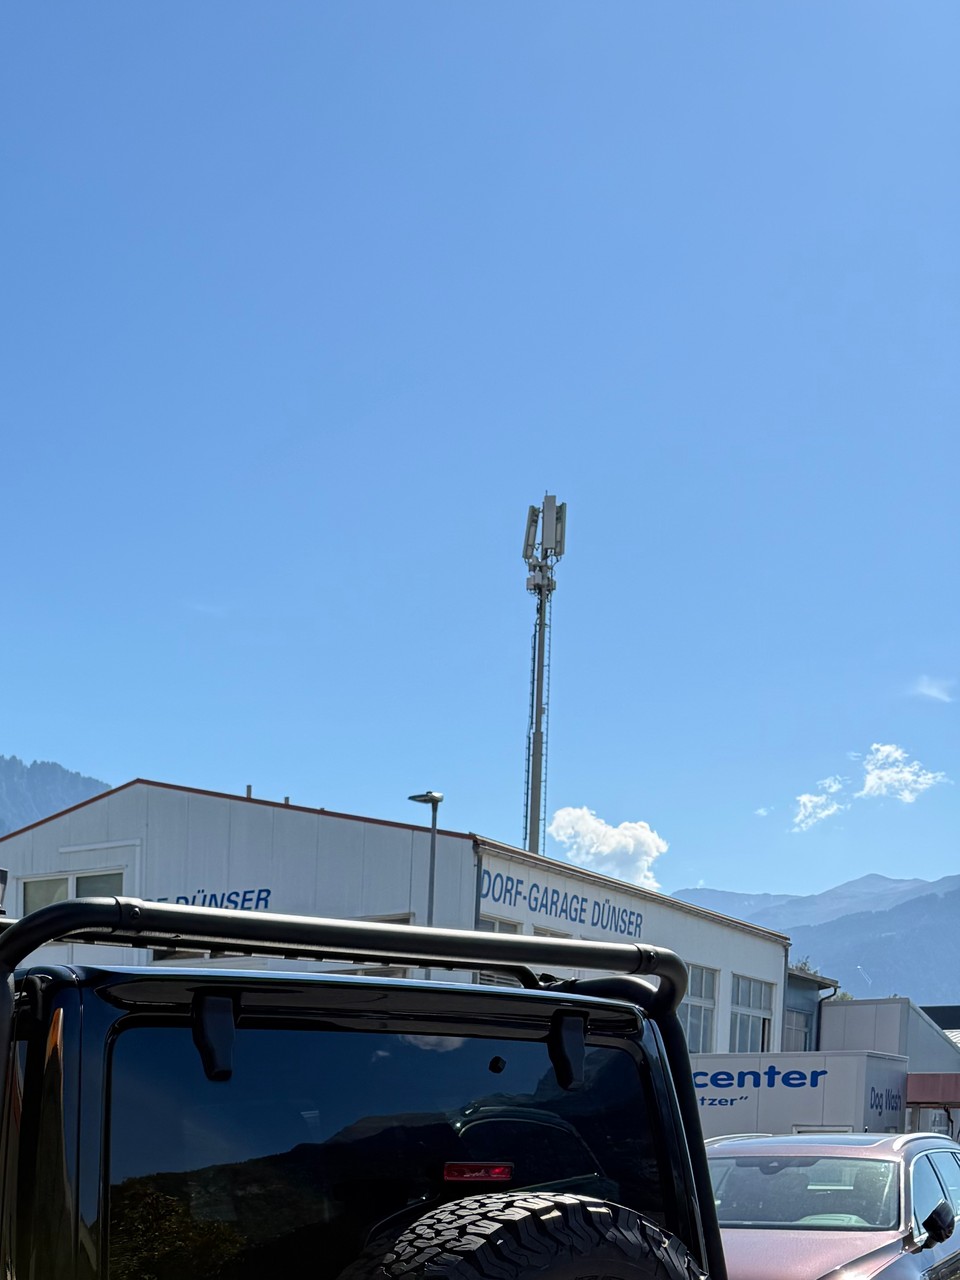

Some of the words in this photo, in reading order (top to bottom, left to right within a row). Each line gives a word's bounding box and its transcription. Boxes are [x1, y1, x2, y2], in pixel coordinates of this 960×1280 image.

[480, 869, 588, 924] DORF-GARAGE
[591, 899, 643, 938] DÜNSER
[870, 1087, 883, 1116] Dog
[885, 1088, 901, 1112] Wash
